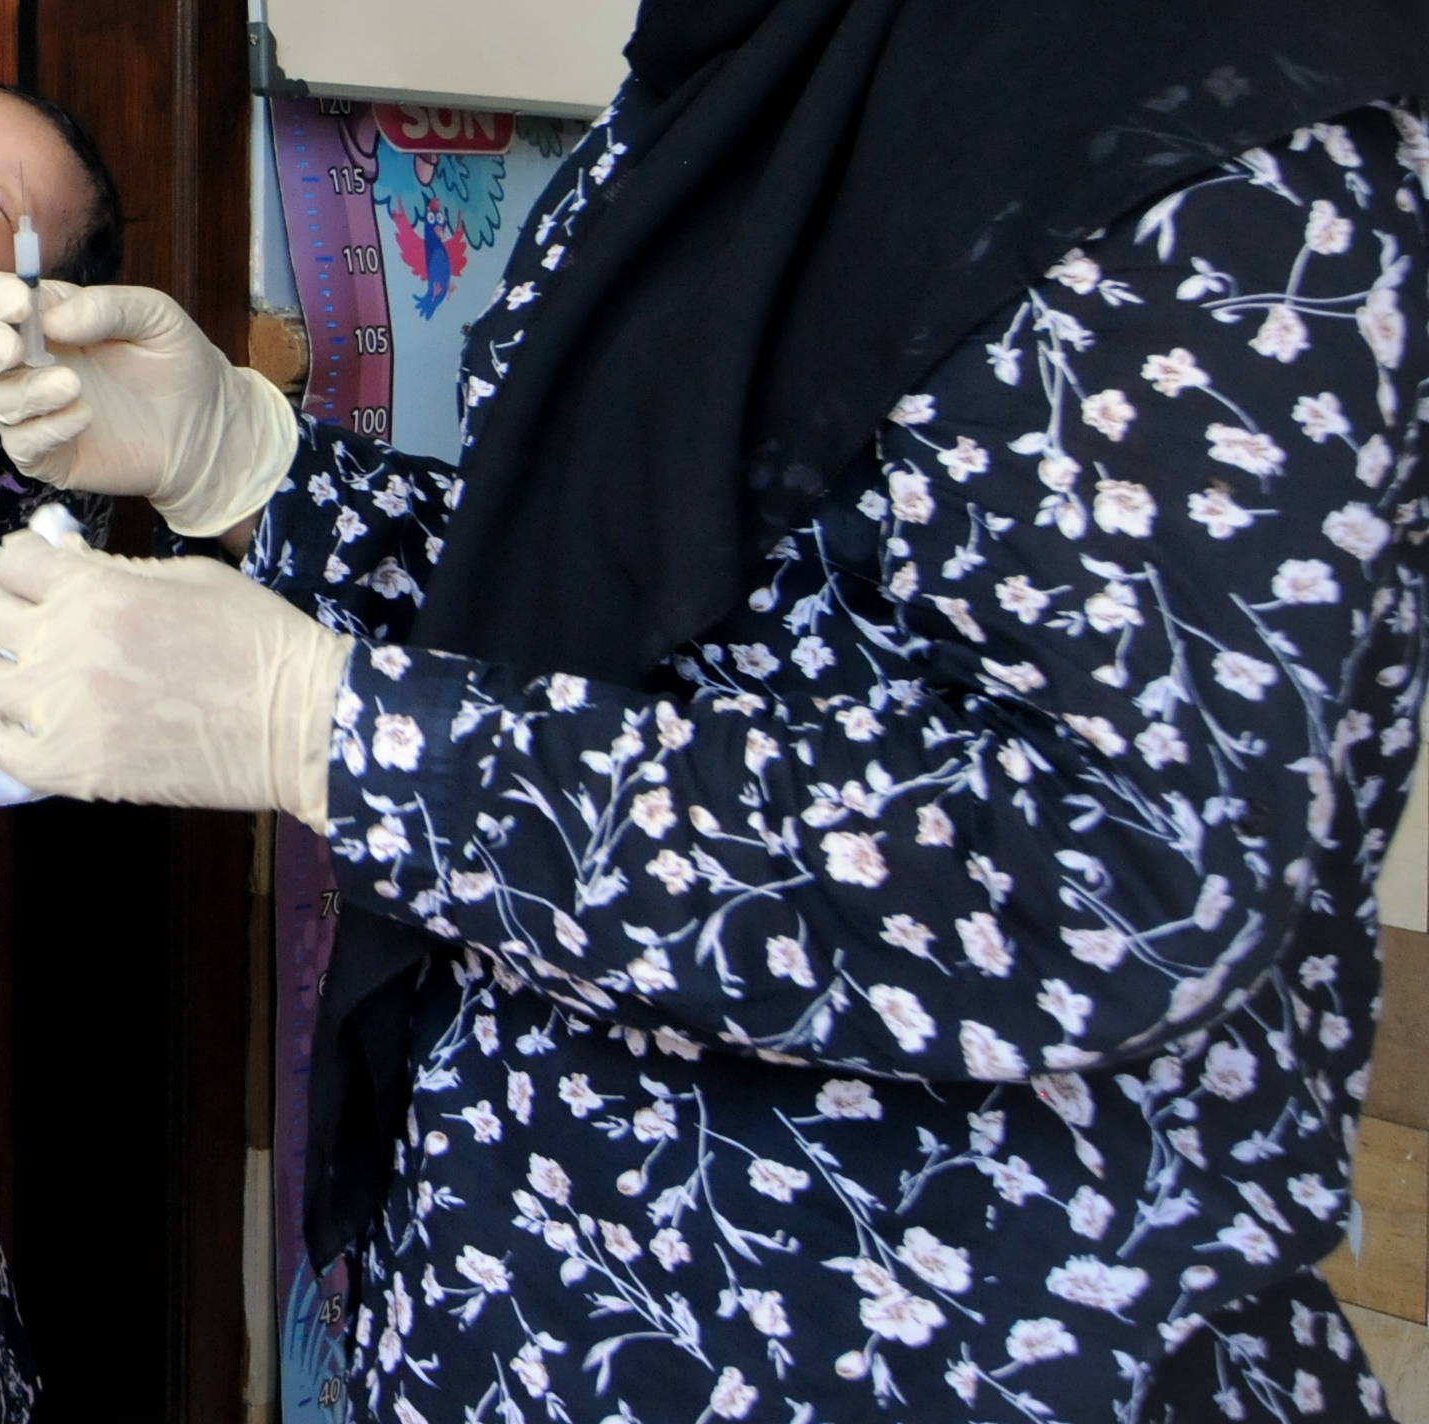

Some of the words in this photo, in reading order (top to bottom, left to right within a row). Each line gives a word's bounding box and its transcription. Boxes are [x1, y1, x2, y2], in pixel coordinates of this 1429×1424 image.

[329, 168, 366, 194] 115
[343, 247, 378, 274] 110
[354, 328, 389, 354] 105
[351, 408, 387, 434] 100
[320, 1295, 341, 1324] 45
[319, 1378, 341, 1405] 40
